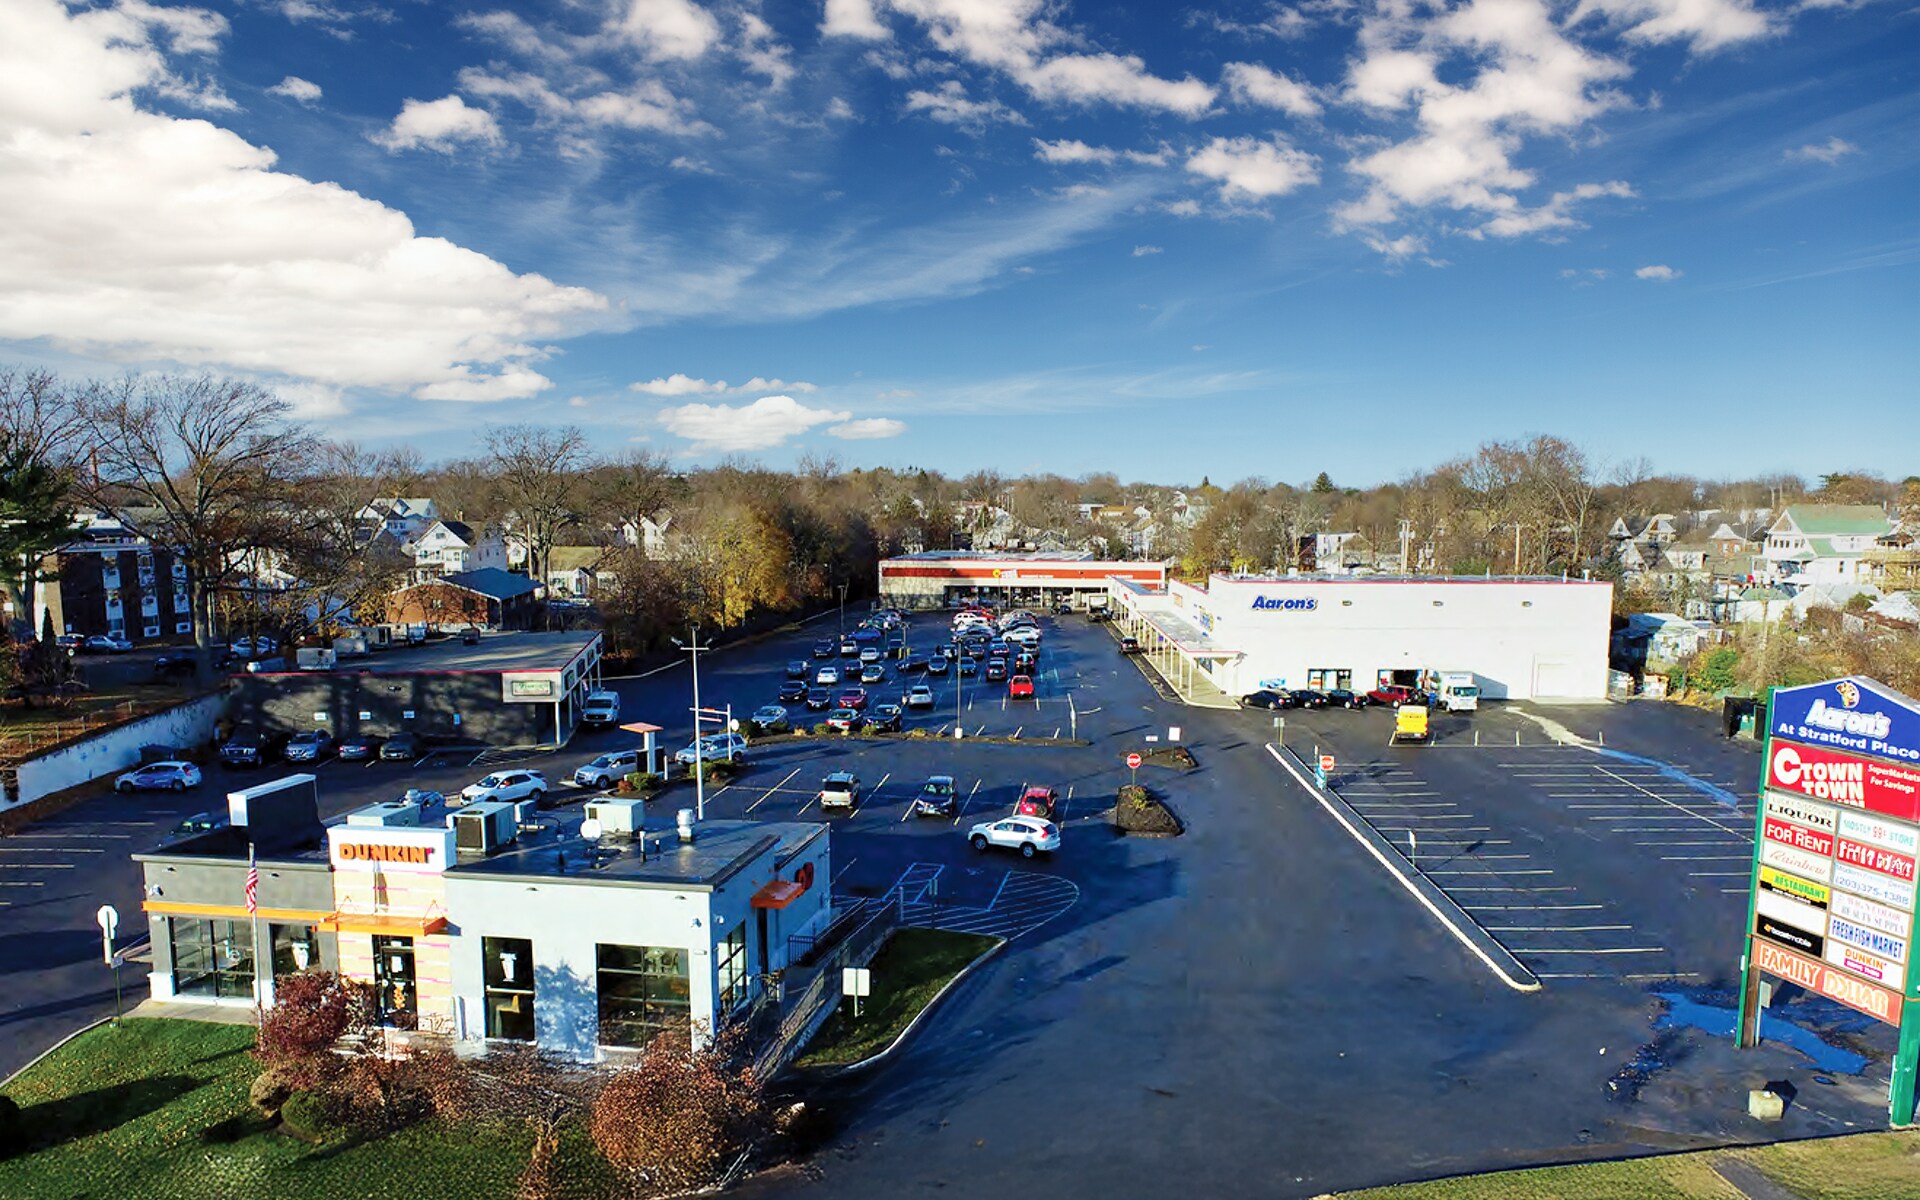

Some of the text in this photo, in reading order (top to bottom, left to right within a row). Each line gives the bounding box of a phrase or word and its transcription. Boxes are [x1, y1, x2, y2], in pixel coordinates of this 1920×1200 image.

[1251, 595, 1318, 611] Aaron's
[1805, 699, 1891, 739] Aaron's
[1779, 723, 1920, 759] At Stratford Place
[1870, 776, 1883, 785] For
[1768, 803, 1832, 828] LIQUOR
[1767, 824, 1792, 843] FOR
[1795, 832, 1831, 854] RENT
[339, 843, 434, 863] DUNKIN'
[1769, 851, 1826, 875] Rainbow
[1774, 875, 1826, 900] RESTAURANT
[1832, 919, 1903, 959] FRESH FISH MARKET
[1760, 944, 1821, 988] FAMILY
[1845, 948, 1887, 969] DUNKIN'
